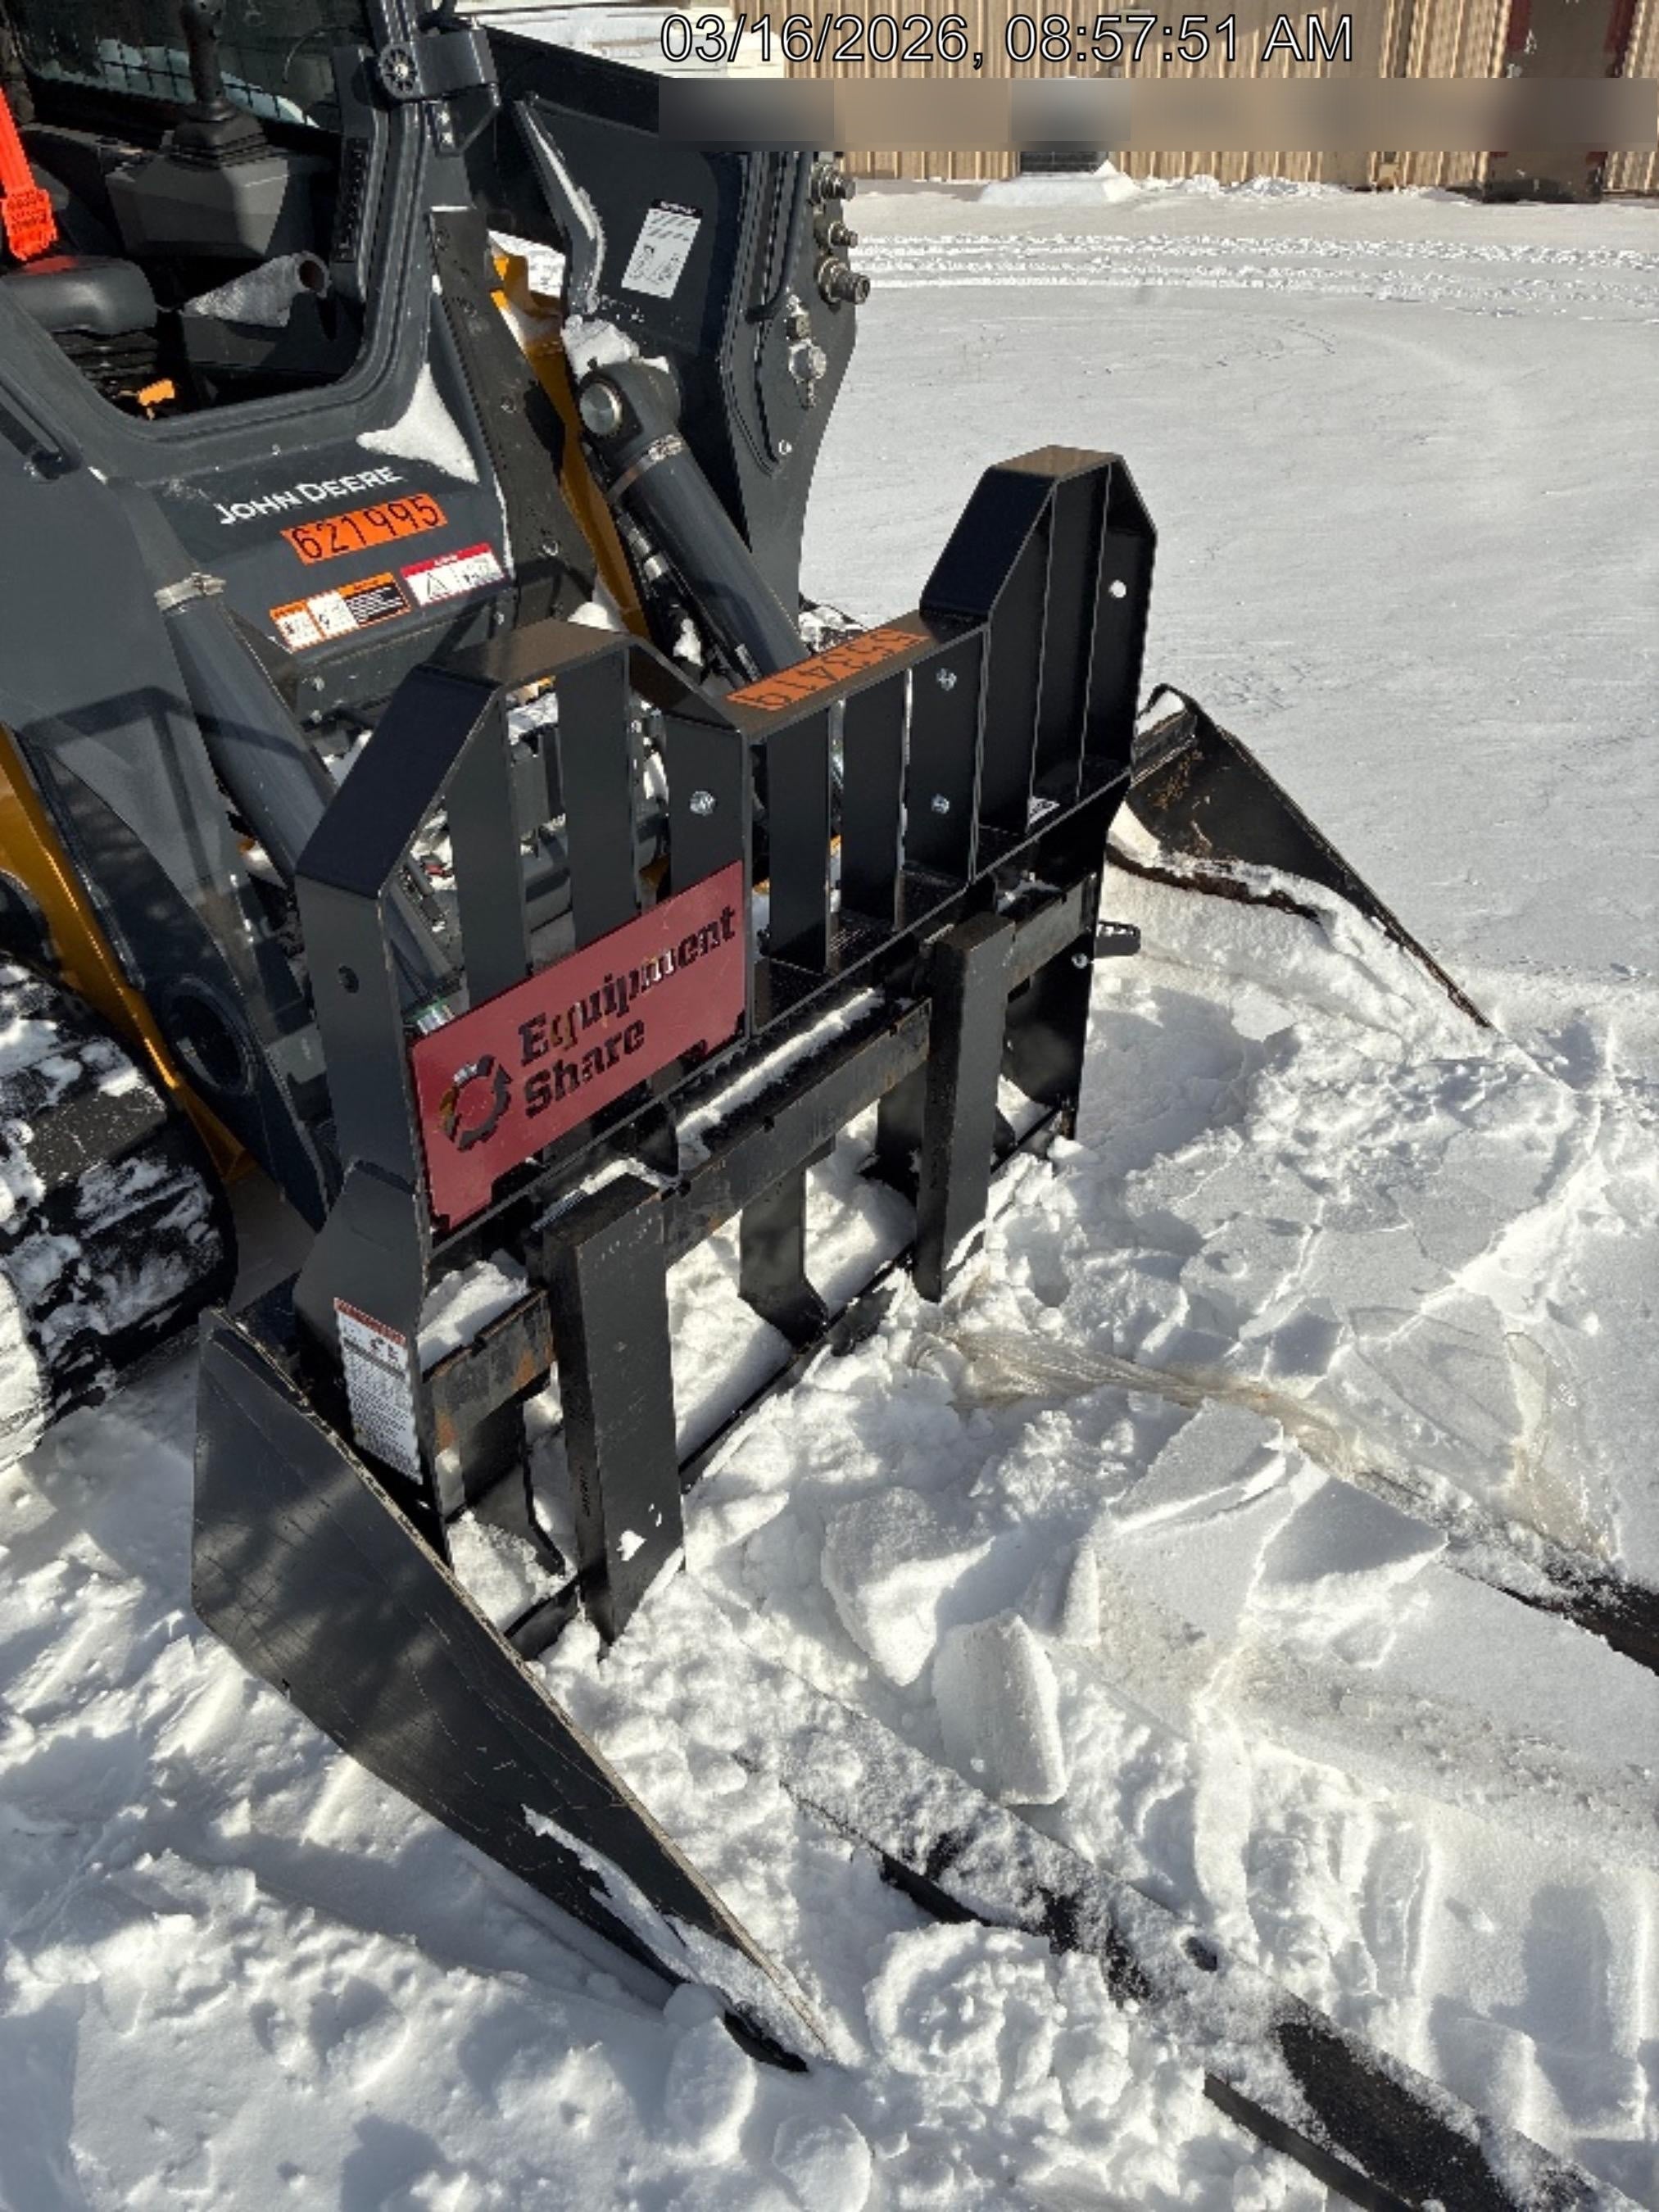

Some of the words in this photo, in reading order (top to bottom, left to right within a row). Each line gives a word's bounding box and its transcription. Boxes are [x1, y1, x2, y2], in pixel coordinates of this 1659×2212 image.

[213, 491, 303, 525] JOHN
[296, 466, 405, 504] DEERE
[291, 493, 439, 559] 621995
[518, 905, 736, 1067] Equipment
